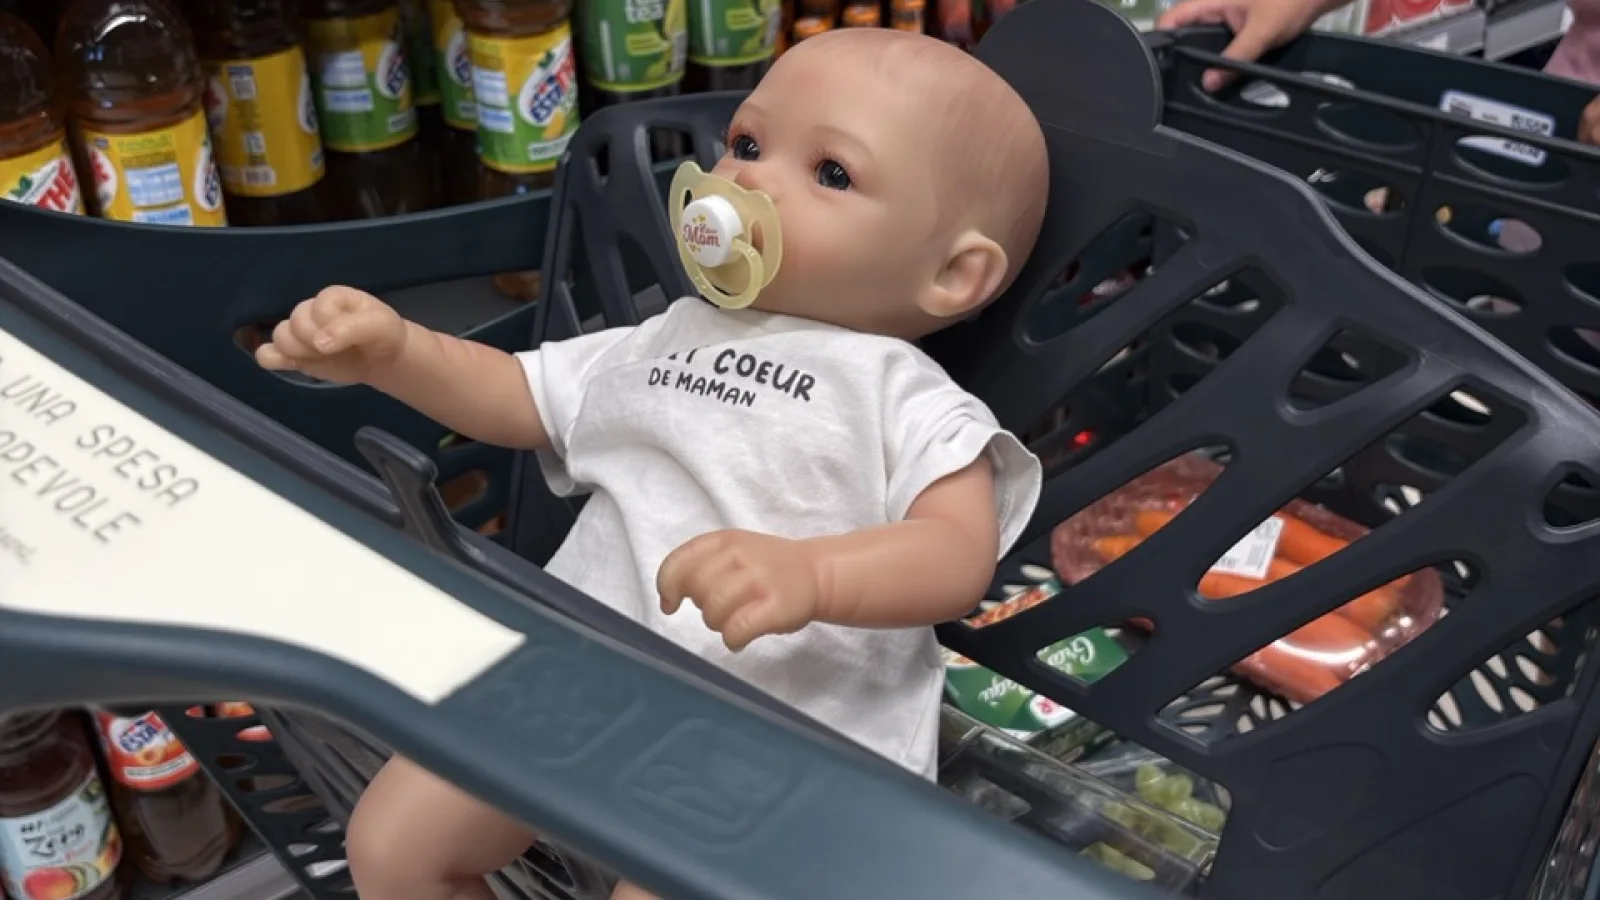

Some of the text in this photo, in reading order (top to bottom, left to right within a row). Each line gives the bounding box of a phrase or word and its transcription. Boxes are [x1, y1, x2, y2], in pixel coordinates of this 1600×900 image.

[648, 366, 756, 407] DE MAMAN
[713, 348, 815, 402] COEUR
[0, 373, 200, 508] UNA SPESA
[1047, 637, 1096, 667] Gra
